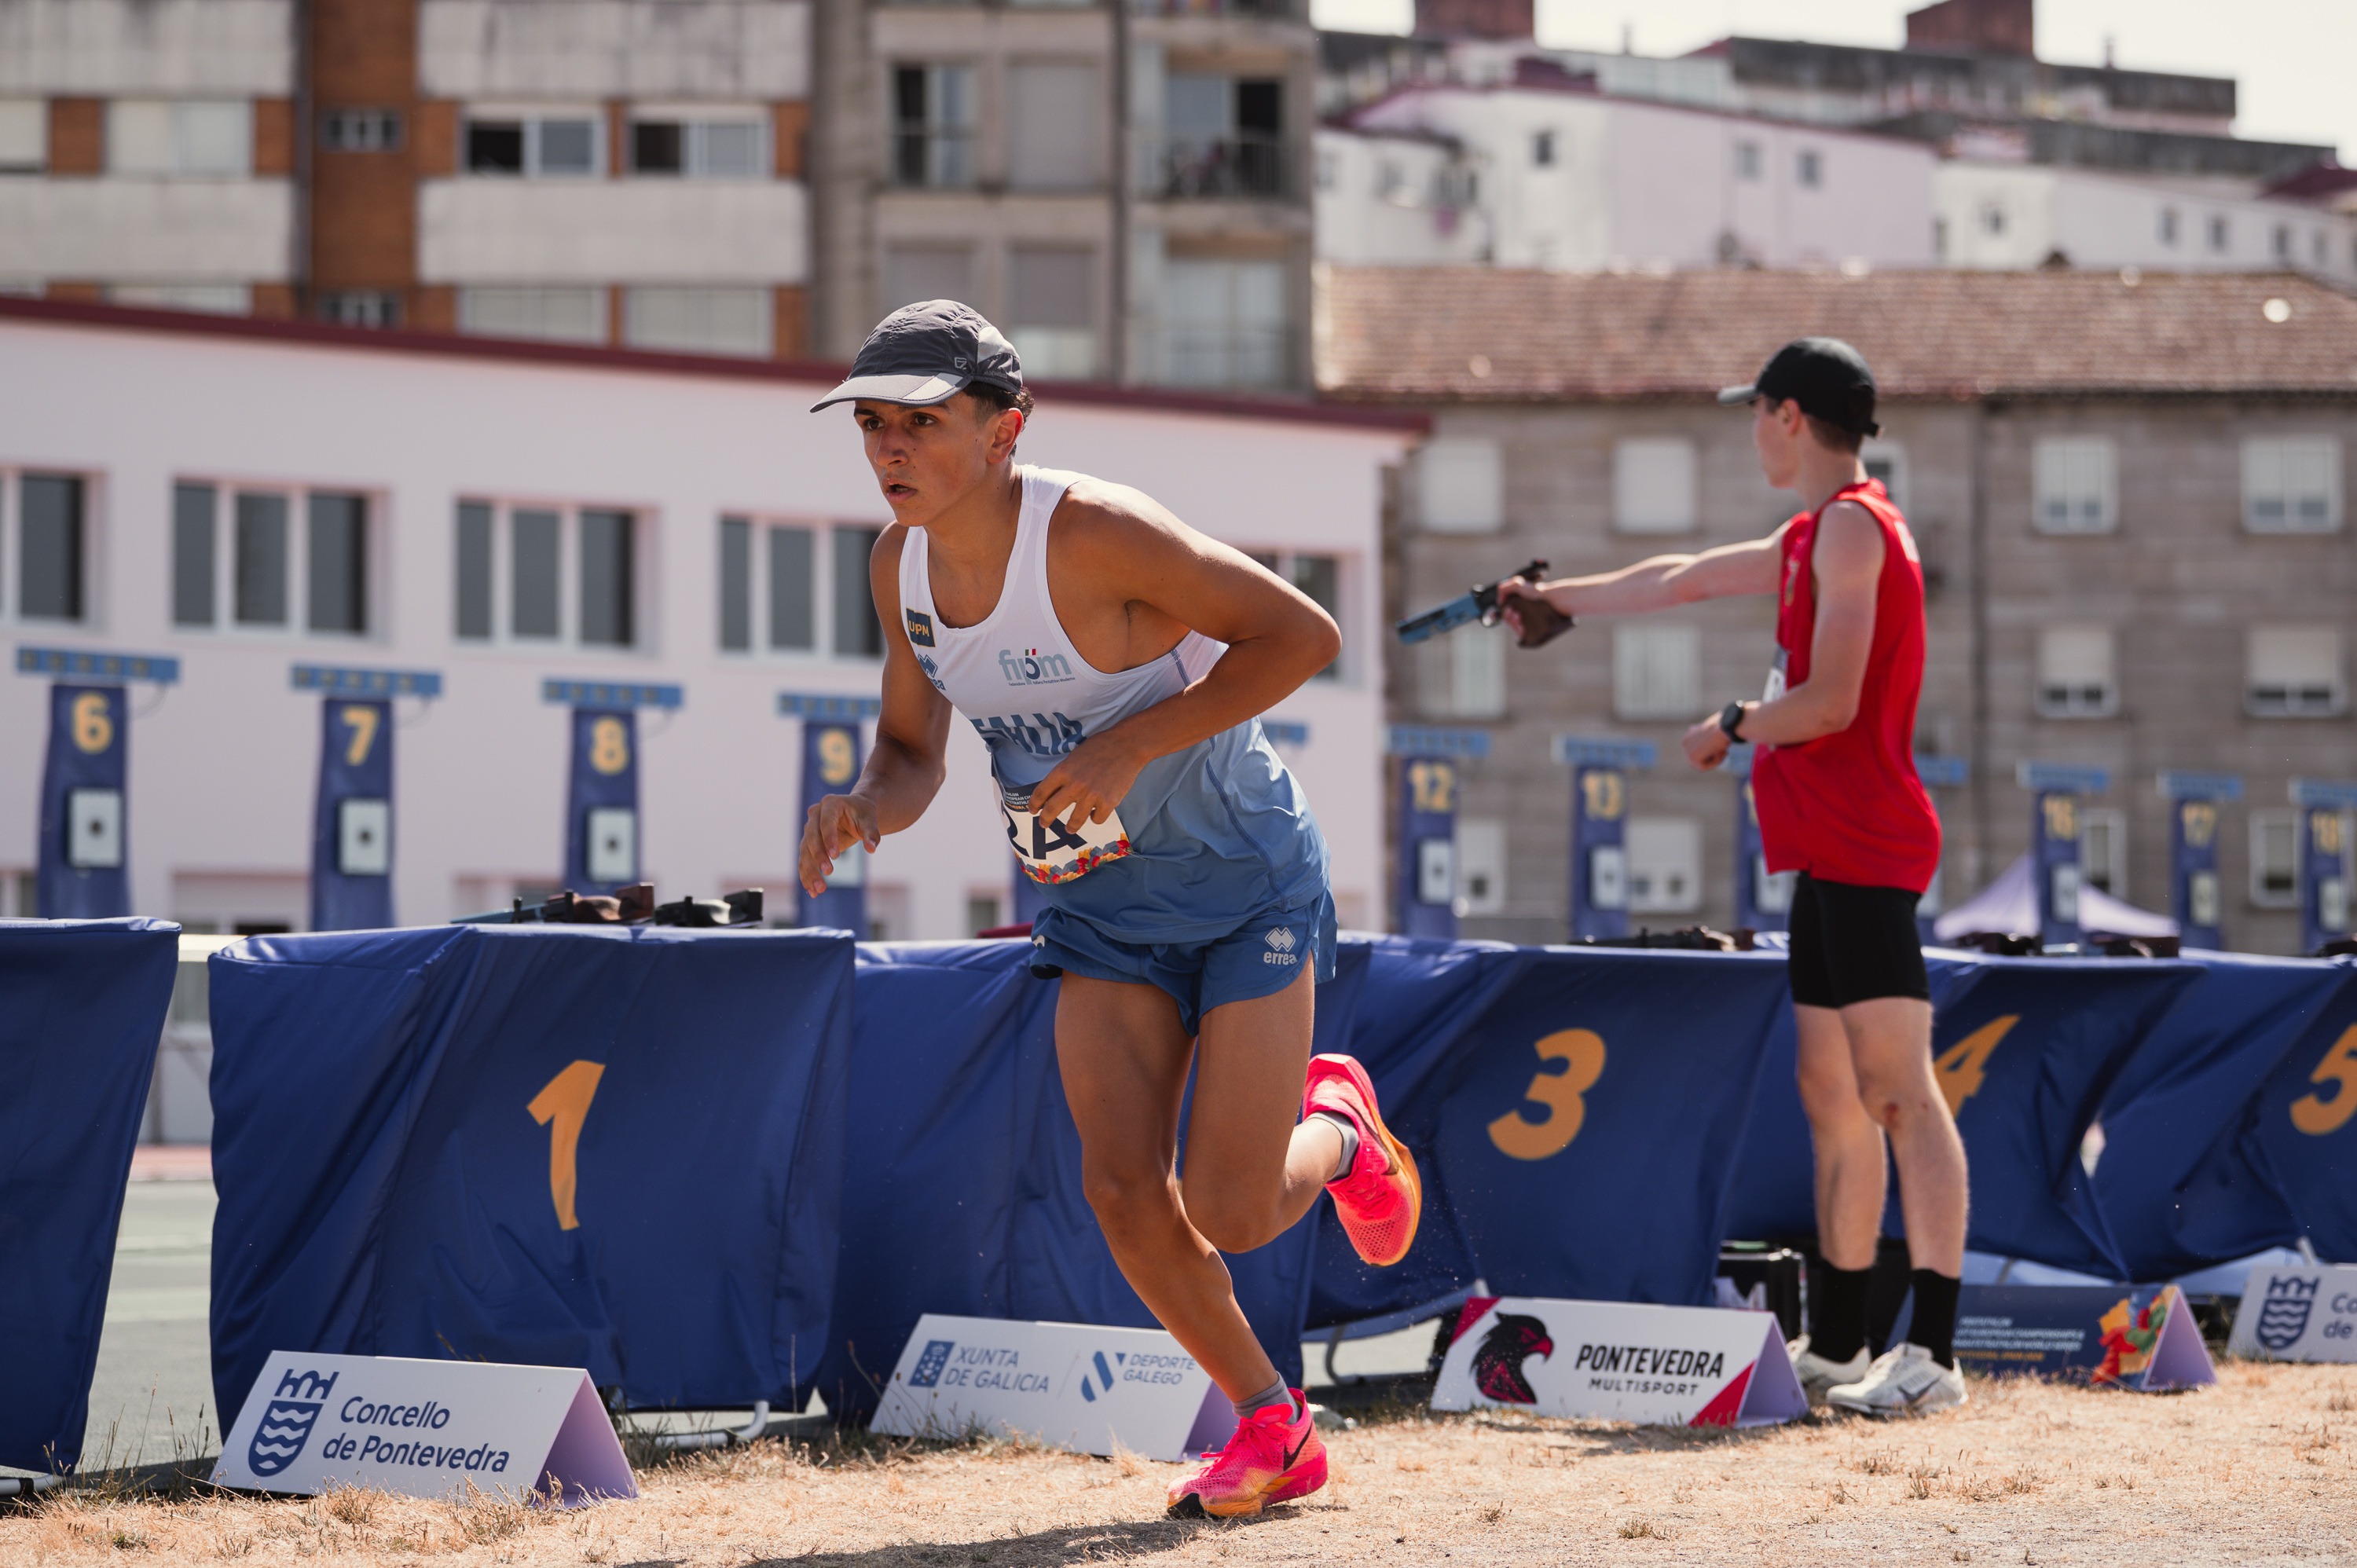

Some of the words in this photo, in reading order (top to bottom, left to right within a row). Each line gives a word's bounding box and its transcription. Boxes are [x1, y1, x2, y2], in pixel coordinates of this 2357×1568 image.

[909, 620, 930, 637] UPM
[71, 692, 113, 753] 6
[342, 705, 379, 766] 7
[592, 716, 628, 776] 8
[819, 727, 855, 785] 9
[1409, 762, 1456, 813] 12
[1582, 770, 1625, 819] 13
[1934, 1014, 2020, 1120] 4
[2289, 1021, 2357, 1136] 5
[1487, 1028, 1607, 1161] 3
[526, 1059, 606, 1231] 1
[944, 1368, 967, 1387] DE
[974, 1371, 1050, 1394] GALICIA
[955, 1346, 1019, 1368] XUNTA
[1123, 1368, 1182, 1385] GALEGO
[1129, 1354, 1196, 1371] DEPORTE
[1575, 1344, 1725, 1379] PONTEVEDRA
[340, 1395, 450, 1429] Concello
[1588, 1378, 1700, 1397] MULTISPORT
[323, 1432, 357, 1461] de
[359, 1435, 510, 1472] Pontevedra
